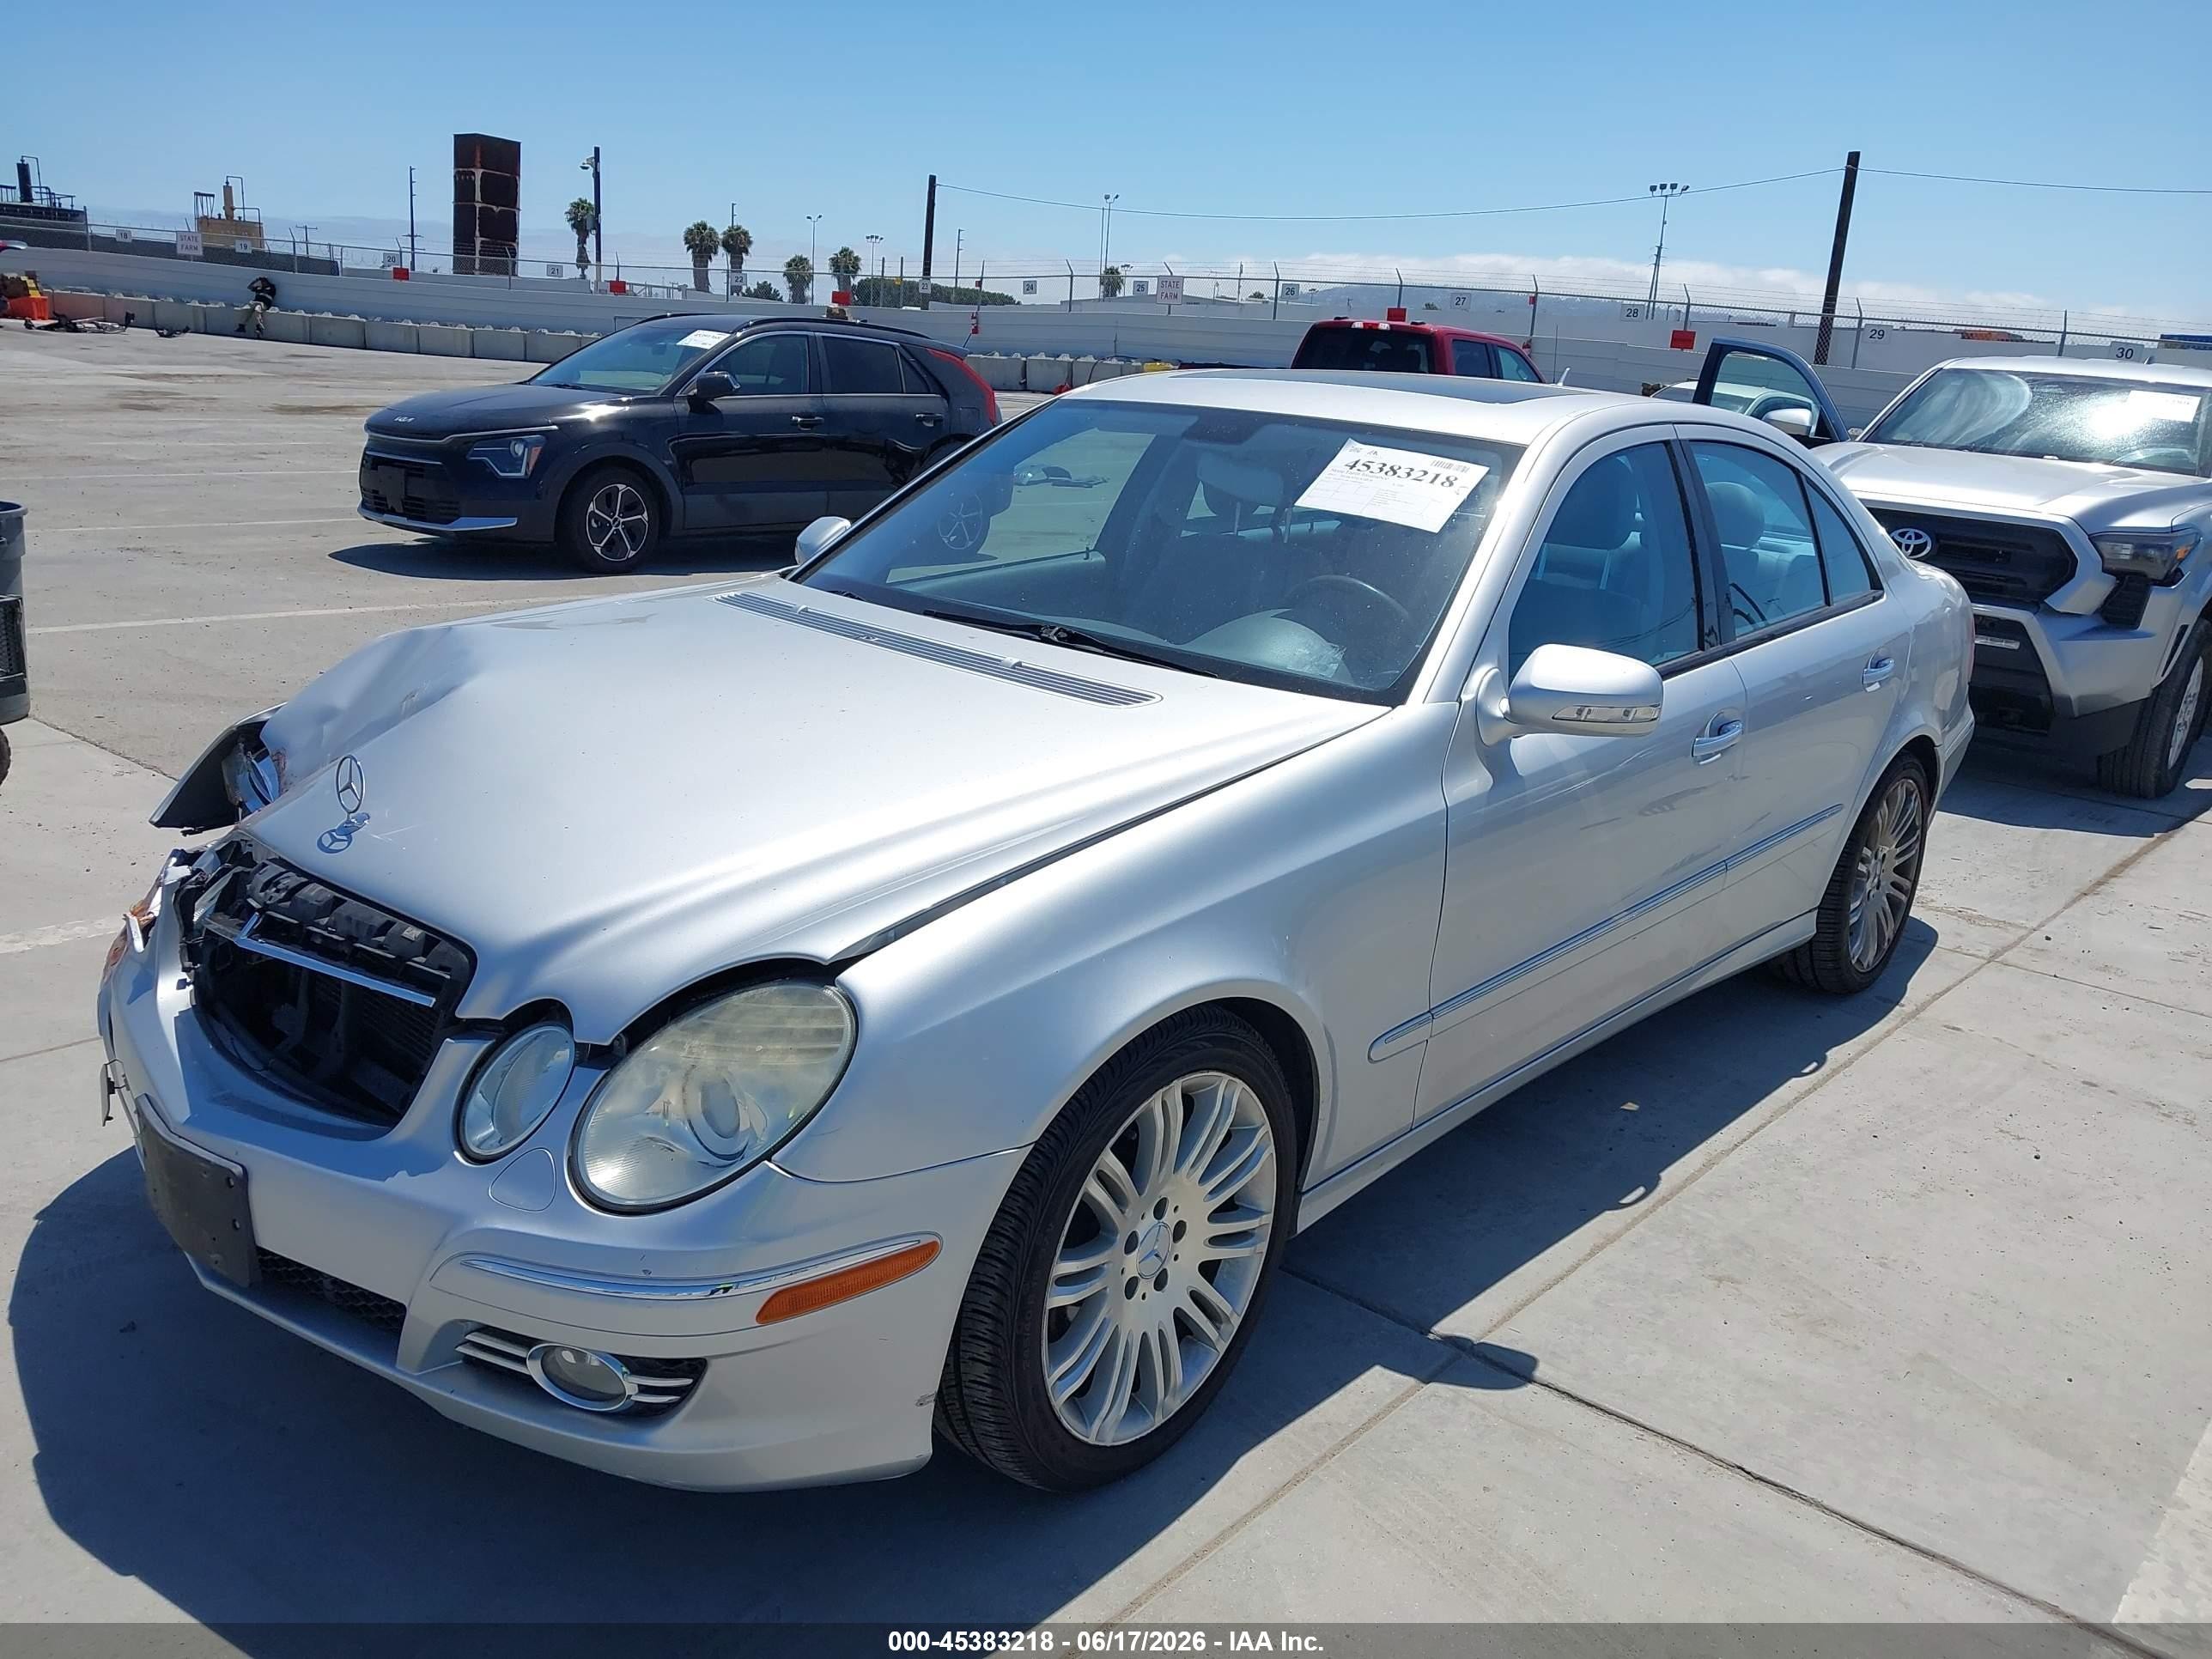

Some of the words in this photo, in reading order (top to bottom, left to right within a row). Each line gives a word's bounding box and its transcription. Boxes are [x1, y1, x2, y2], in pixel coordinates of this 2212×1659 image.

[1160, 280, 1180, 289] STATE
[1160, 291, 1178, 301] FARM
[1285, 287, 1296, 295] 26
[1455, 296, 1467, 306] 27
[1626, 308, 1639, 318] 28
[1869, 328, 1885, 340] 29
[2116, 347, 2134, 359] 30
[1344, 459, 1458, 488] 45383218
